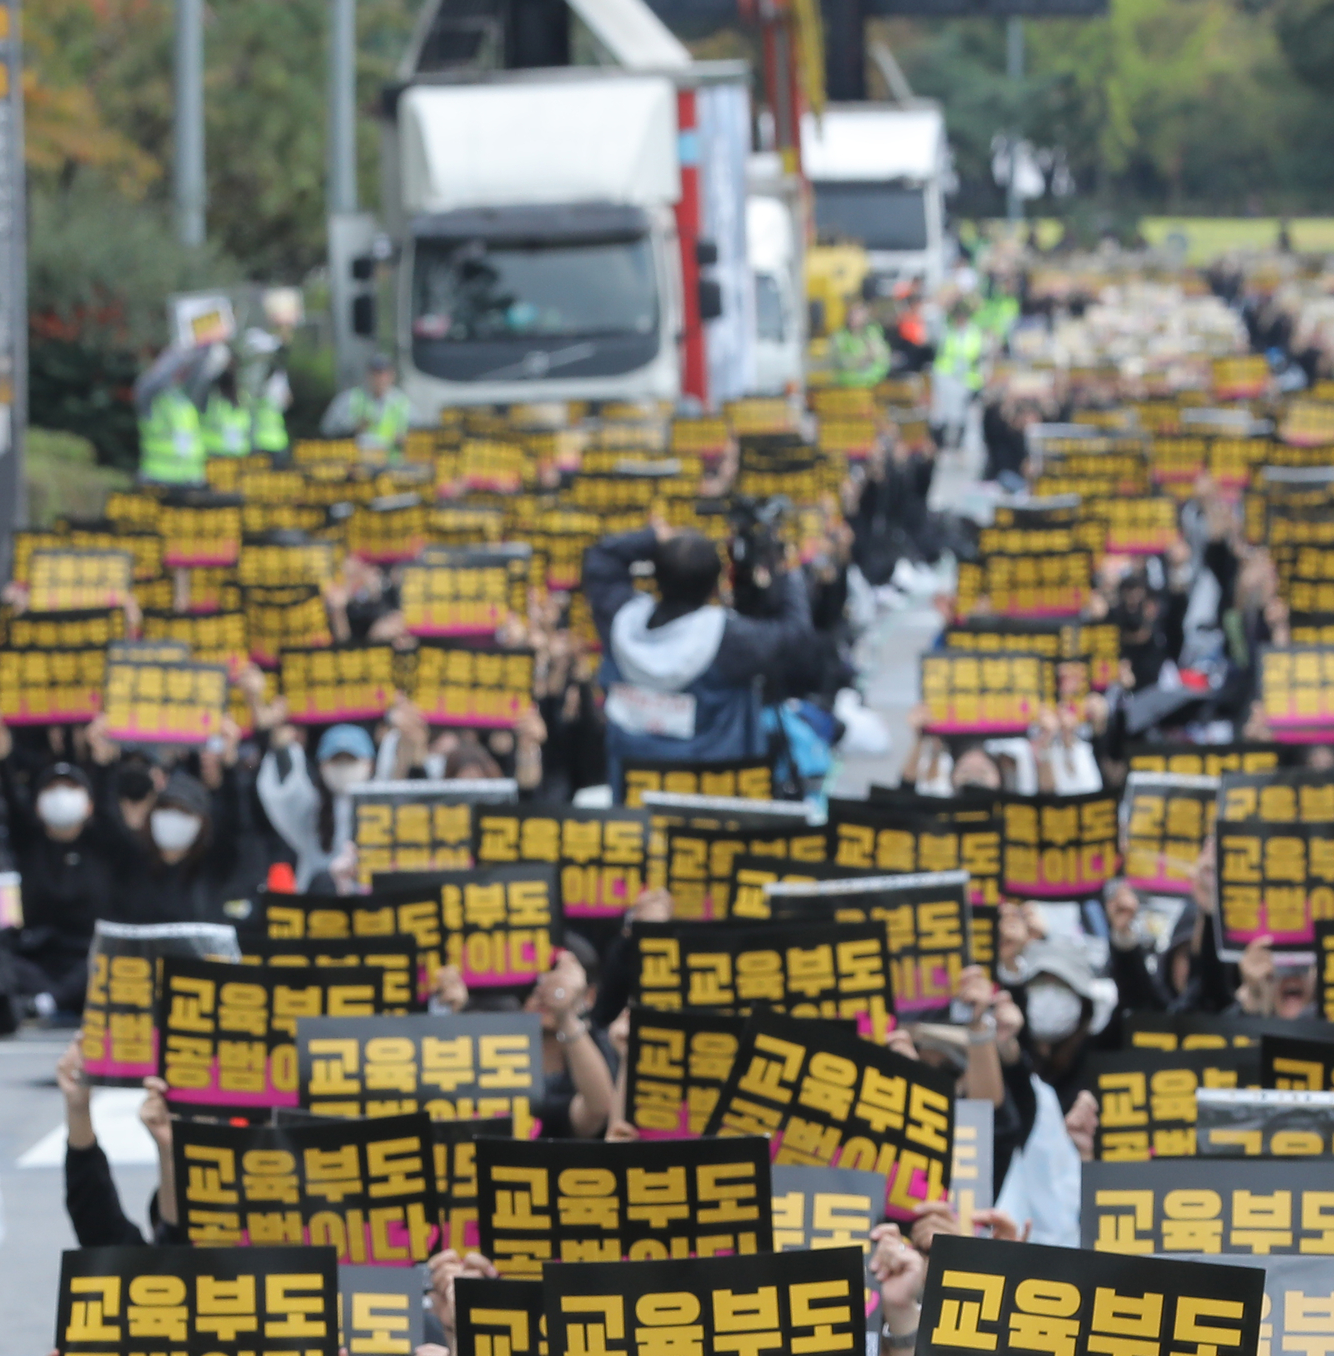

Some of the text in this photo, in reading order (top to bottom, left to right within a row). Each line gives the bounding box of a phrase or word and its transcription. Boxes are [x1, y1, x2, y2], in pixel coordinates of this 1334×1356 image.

[480, 817, 645, 862] 교육부도
[90, 954, 163, 1006] 교육
[686, 938, 886, 1004] 교육부도
[308, 1035, 532, 1093] 교육부도
[738, 1034, 950, 1153] 교육부도
[184, 1136, 436, 1204] 교육부도
[489, 1162, 759, 1230] 교육부도
[64, 1273, 327, 1342] 교육부도
